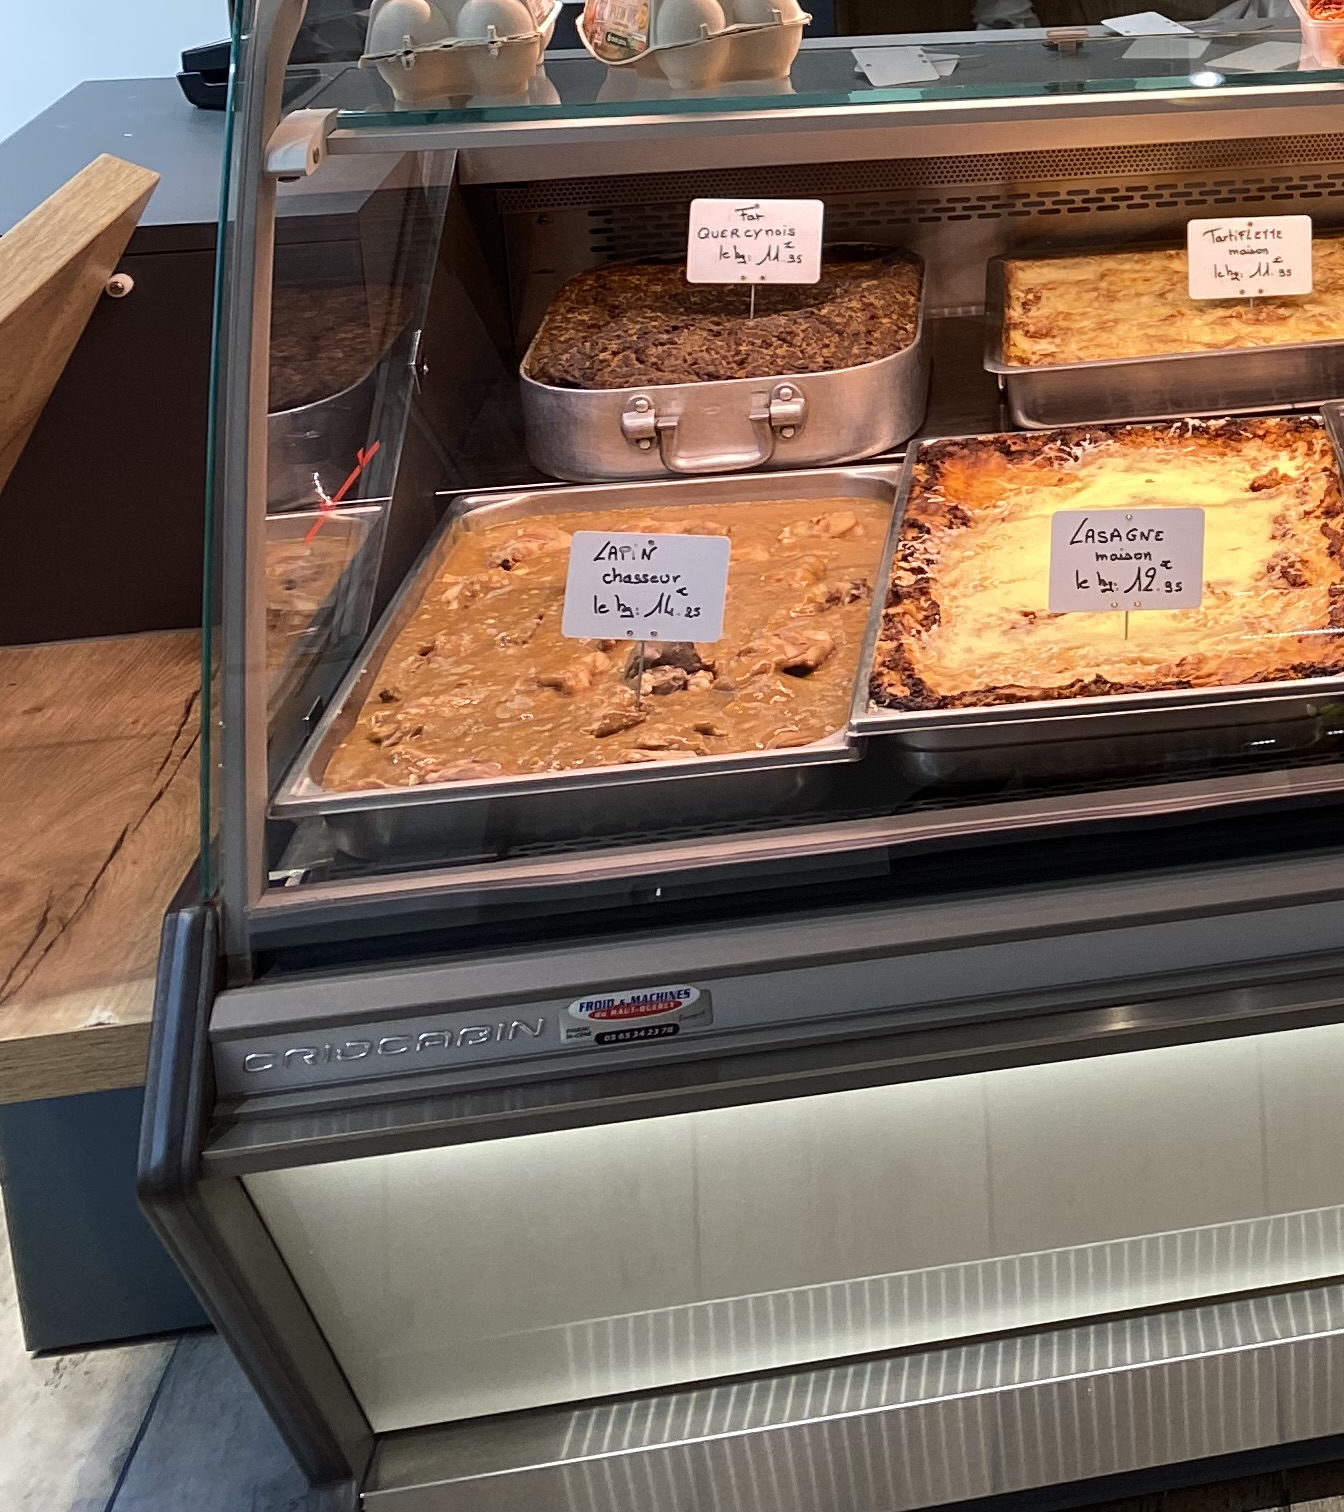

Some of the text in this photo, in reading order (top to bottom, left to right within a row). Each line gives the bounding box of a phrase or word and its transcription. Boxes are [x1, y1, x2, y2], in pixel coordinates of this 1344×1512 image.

[1228, 245, 1269, 256] maison
[1070, 517, 1164, 545] LASAGNE
[1095, 547, 1153, 562] maison
[602, 568, 681, 585] chasseur
[579, 998, 615, 1013] FROID
[630, 988, 691, 1005] MACHINES
[618, 1031, 631, 1040] 65
[632, 1029, 645, 1038] 34
[647, 1027, 660, 1036] 23
